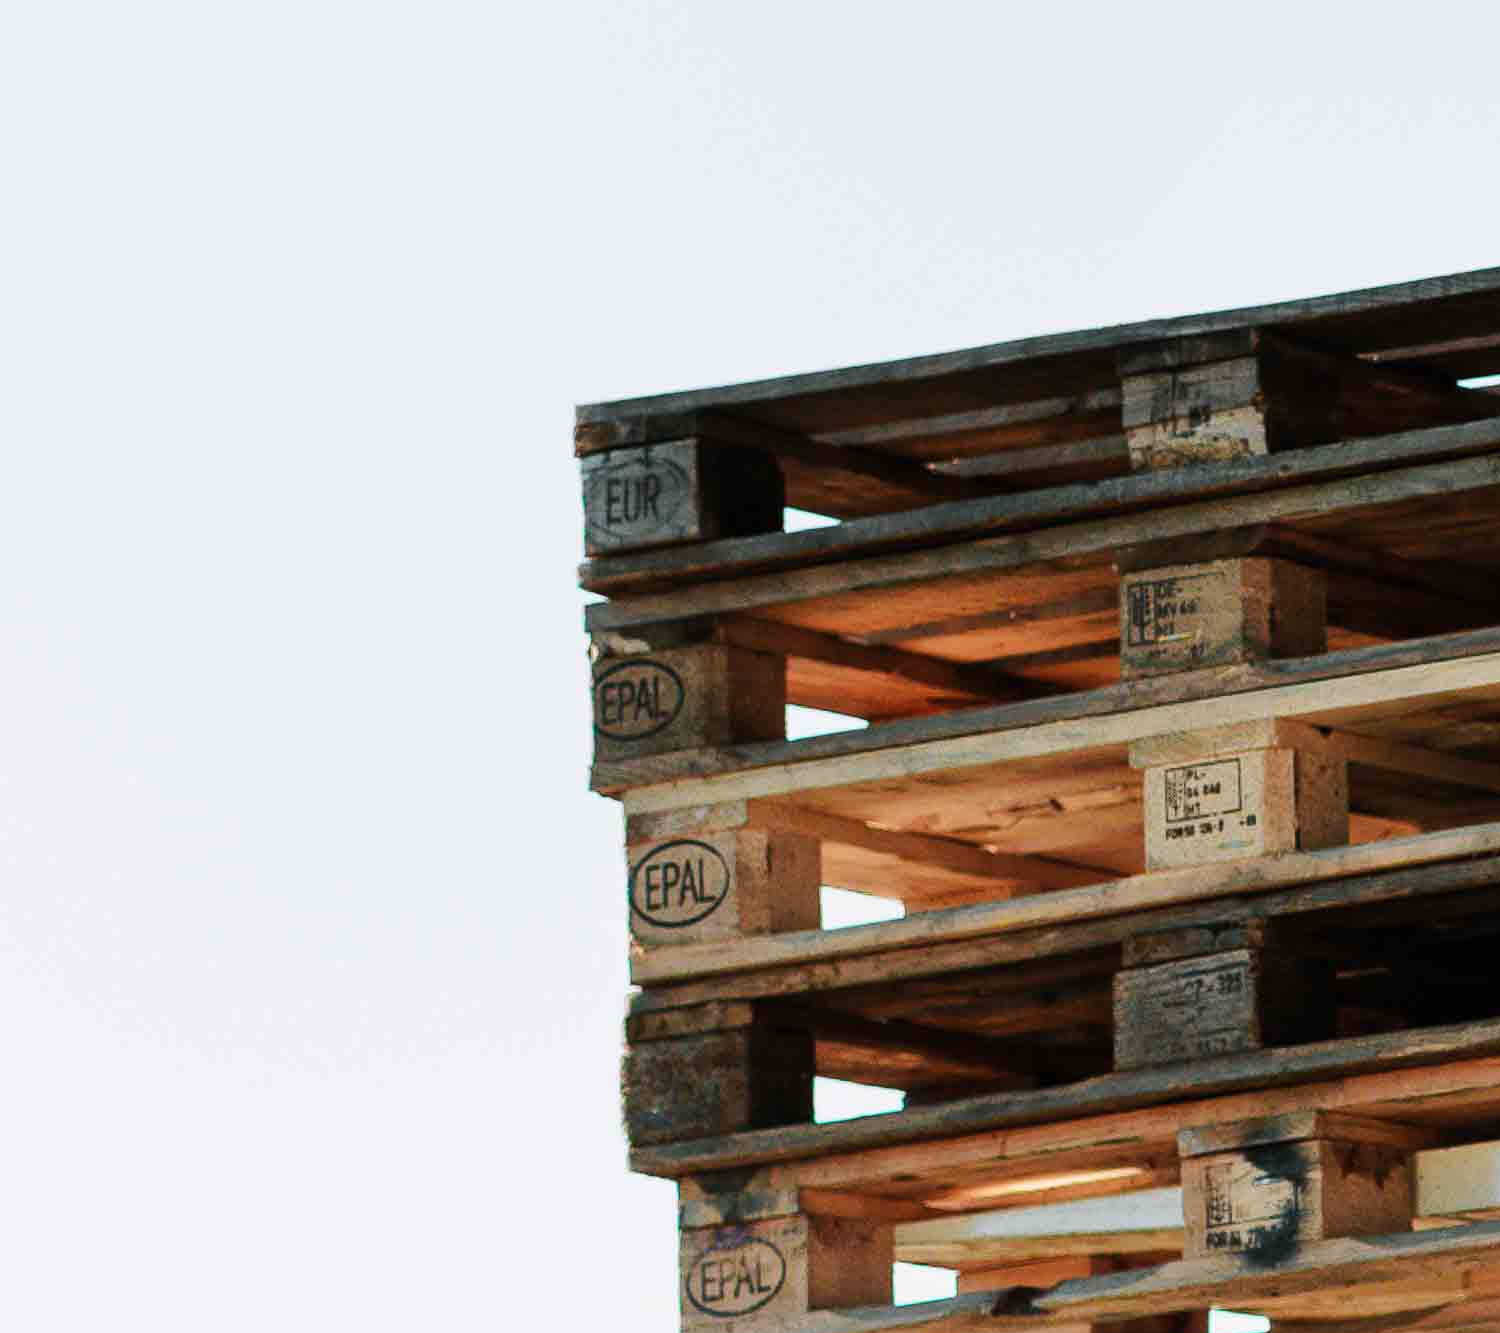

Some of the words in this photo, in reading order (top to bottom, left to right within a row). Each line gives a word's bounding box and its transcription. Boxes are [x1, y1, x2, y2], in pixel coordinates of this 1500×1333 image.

[606, 477, 661, 526] EUR
[600, 680, 668, 724] EPAL
[644, 862, 714, 909] EPAL
